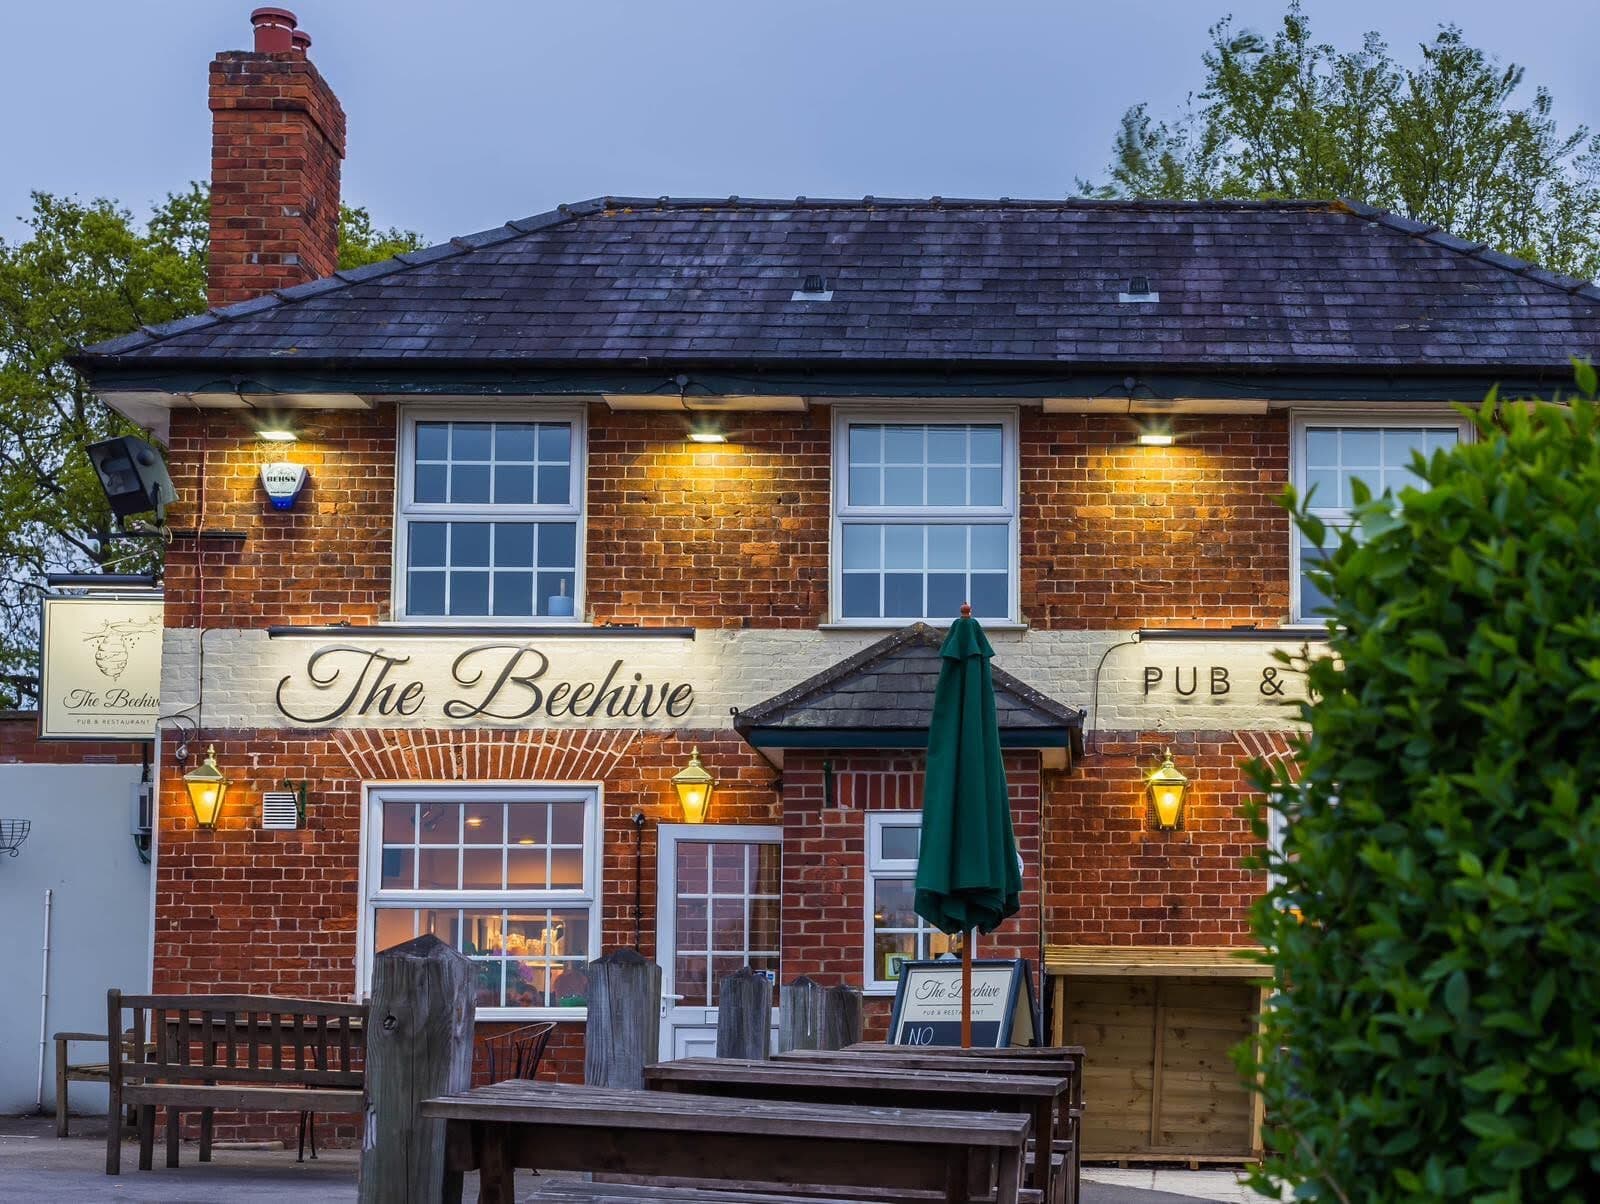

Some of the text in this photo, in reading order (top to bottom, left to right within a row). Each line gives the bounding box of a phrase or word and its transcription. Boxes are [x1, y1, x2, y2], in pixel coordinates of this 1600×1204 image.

[276, 643, 695, 723] The Beehive
[1143, 666, 1231, 696] PUB
[1259, 666, 1285, 696] &
[63, 688, 100, 709] The
[915, 978, 1001, 1000] The Behive
[908, 1026, 934, 1046] NO
